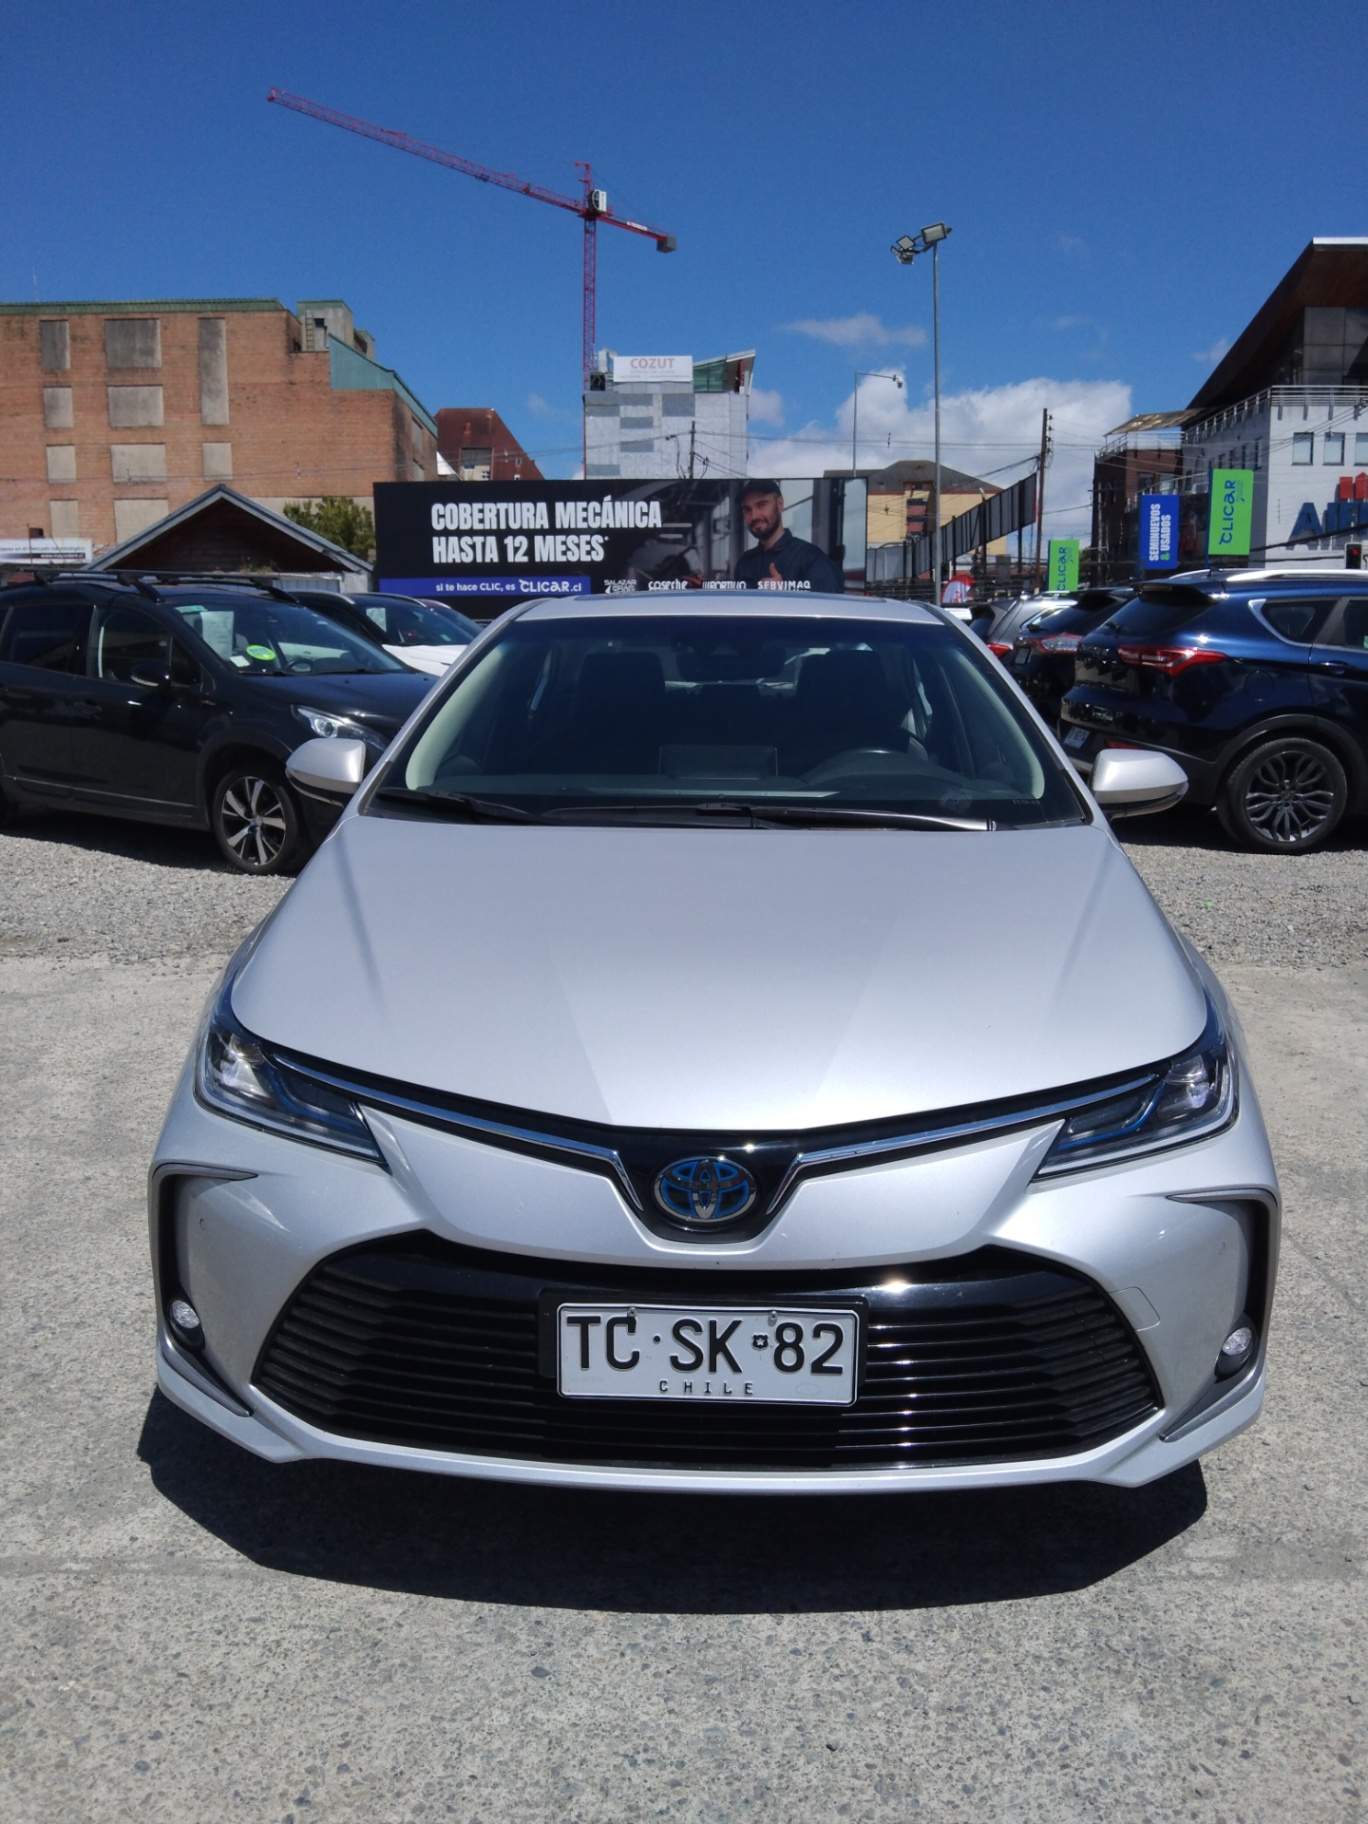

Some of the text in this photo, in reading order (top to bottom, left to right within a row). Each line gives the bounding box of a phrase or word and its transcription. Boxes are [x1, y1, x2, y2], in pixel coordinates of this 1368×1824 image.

[630, 358, 675, 369] COZUT
[431, 495, 662, 531] COBERTURA MECÁNICA
[1149, 503, 1161, 561] SEMINUEVOS
[1160, 514, 1171, 551] USADOS
[432, 535, 499, 563] HASTA
[504, 535, 529, 563] 12
[436, 583, 443, 591] si
[457, 583, 478, 591] hace
[480, 583, 504, 592] CLIC,
[658, 1379, 755, 1396] CHILE
